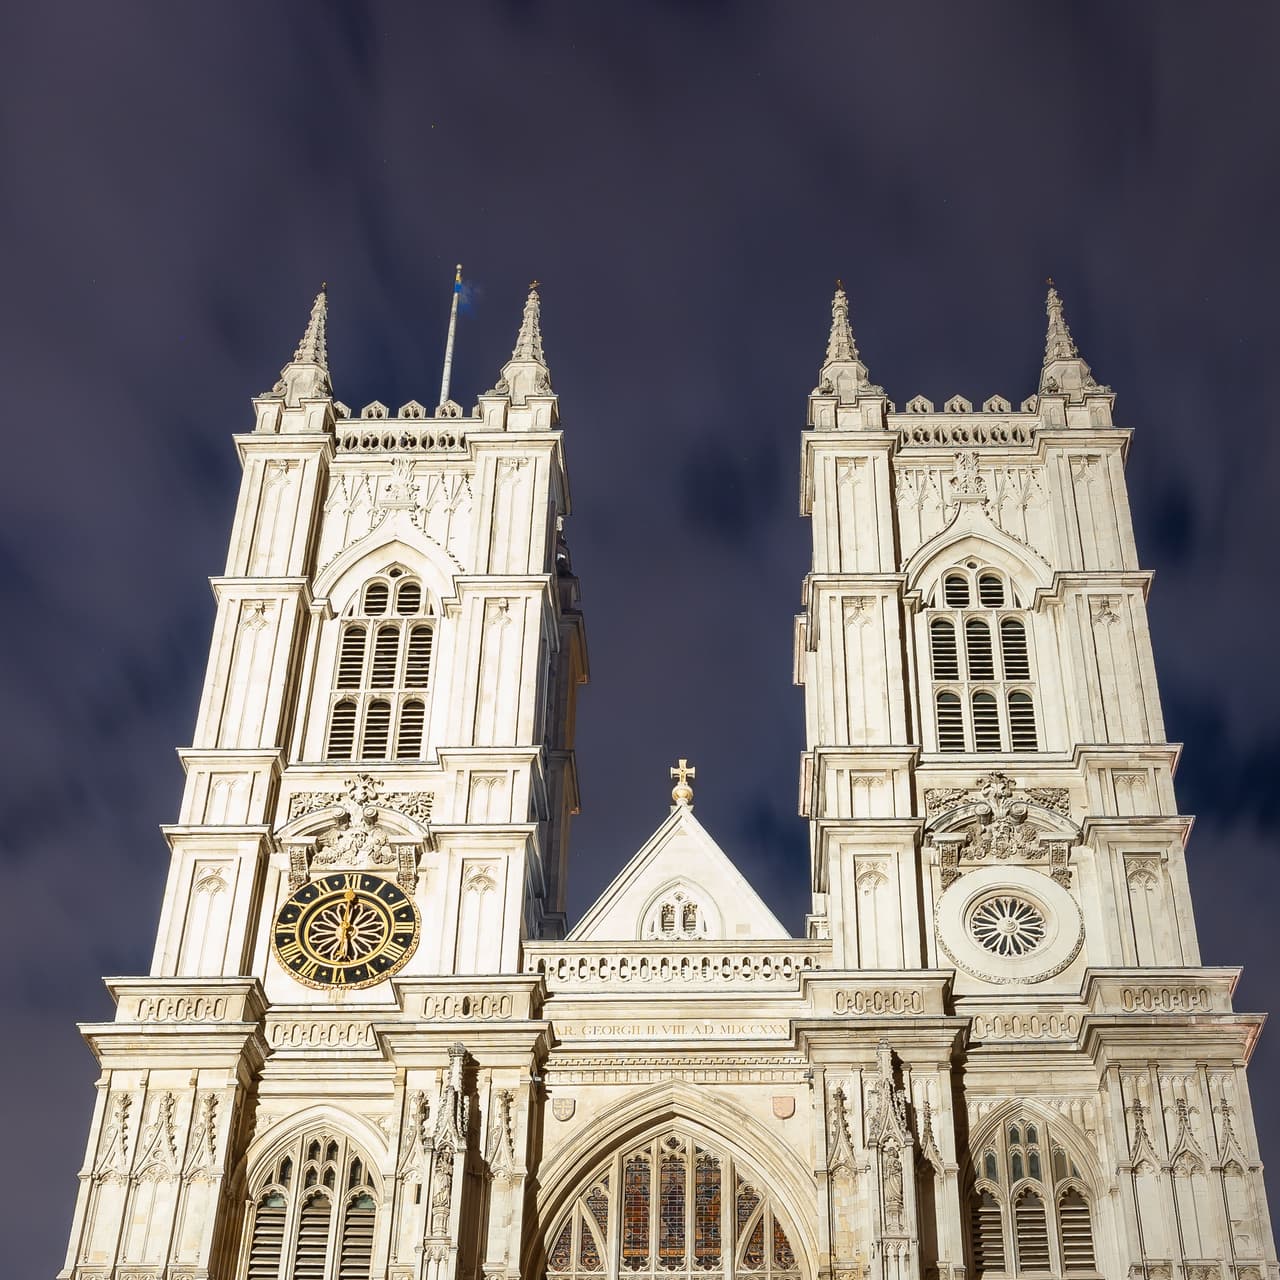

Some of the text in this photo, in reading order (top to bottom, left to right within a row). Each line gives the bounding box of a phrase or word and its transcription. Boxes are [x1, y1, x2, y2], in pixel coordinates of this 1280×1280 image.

[312, 878, 332, 896] XI
[344, 874, 362, 889] XII
[375, 881, 387, 895] I
[288, 897, 308, 911] X
[391, 899, 410, 911] II
[276, 922, 296, 933] IX
[395, 922, 414, 933] III
[278, 941, 300, 961] VIII
[381, 941, 407, 962] IIII
[299, 960, 319, 979] VII
[332, 967, 346, 984] VI
[365, 963, 379, 977] V
